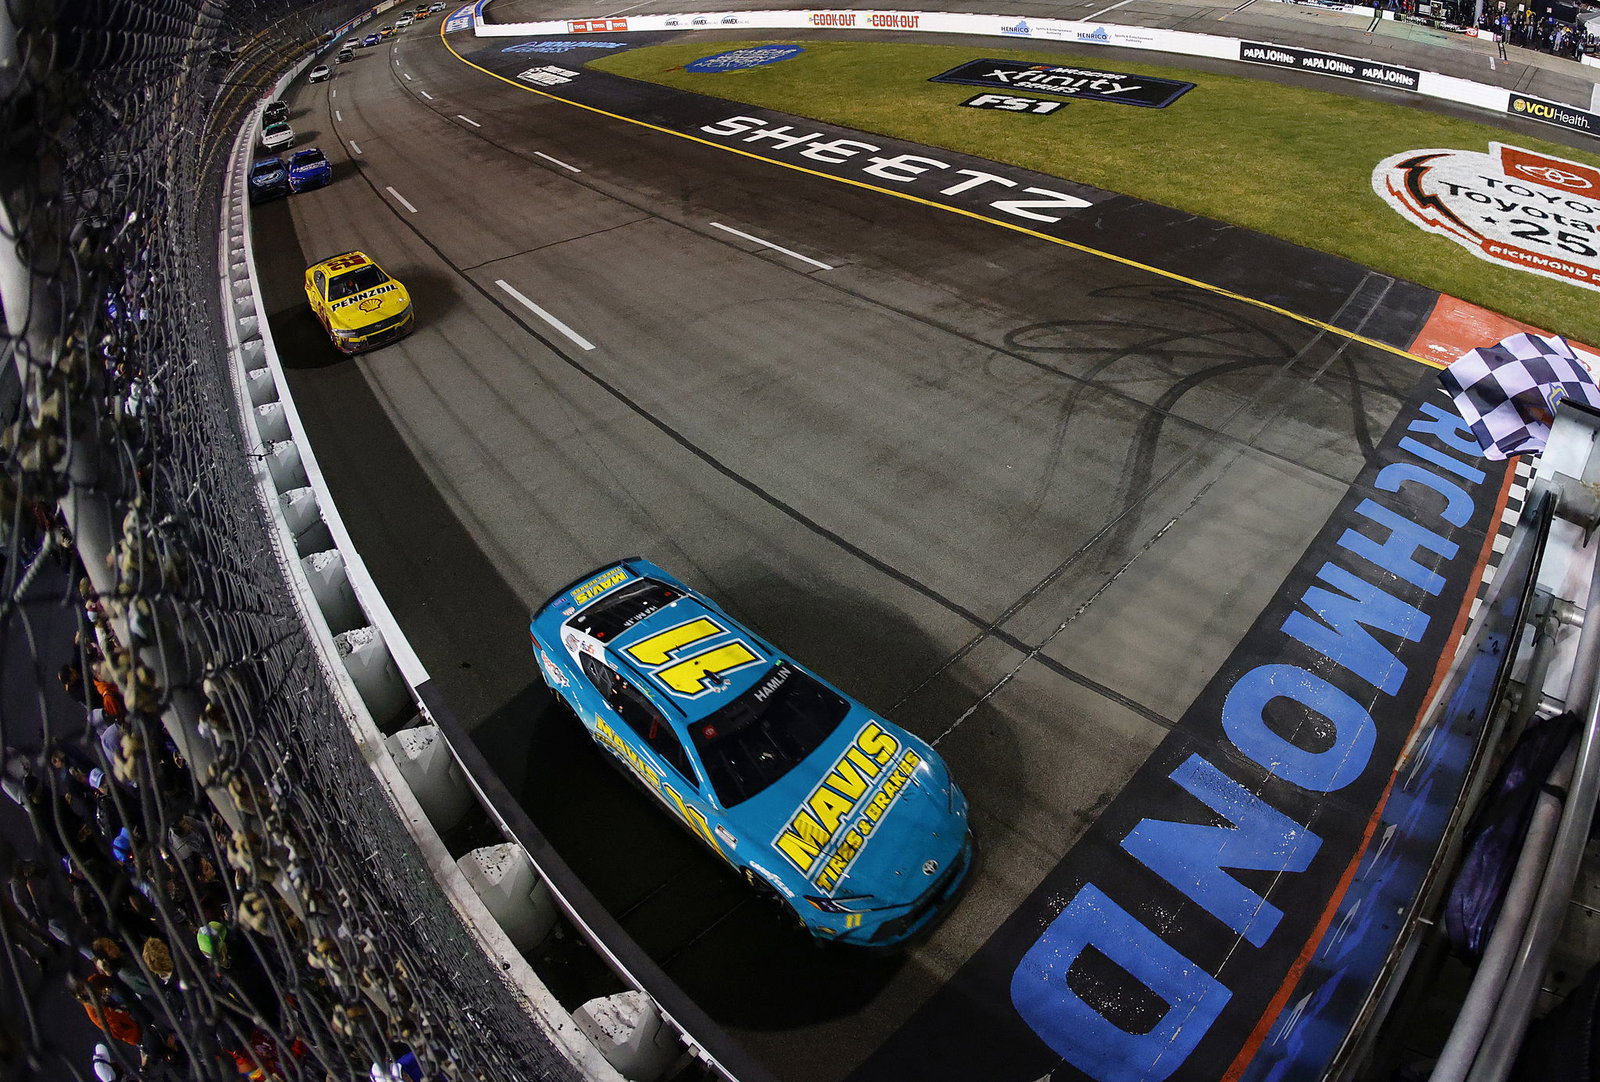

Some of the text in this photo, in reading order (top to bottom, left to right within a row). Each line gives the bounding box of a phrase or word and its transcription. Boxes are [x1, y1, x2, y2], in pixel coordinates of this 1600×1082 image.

[1001, 26, 1029, 34] HENRICO
[1077, 32, 1107, 40] HENRICO
[1244, 49, 1265, 59] PAPA
[1303, 58, 1325, 68] PAPA
[982, 69, 1142, 95] xfinity
[1362, 68, 1384, 79] PAPA
[969, 94, 1061, 114] FS1
[700, 115, 1093, 223] SHEETZ
[1479, 175, 1600, 214] TOYO
[1489, 245, 1588, 278] RICHMOND
[331, 284, 398, 312] PENNZOIL
[576, 571, 627, 604] MAVIS
[622, 616, 763, 698] 11
[754, 667, 791, 702] HAMLIN
[596, 715, 660, 787] MAVIS
[1010, 402, 1487, 1082] RICHMOND
[775, 723, 899, 873] MAVIS
[815, 750, 922, 892] TIRES & BRAKES
